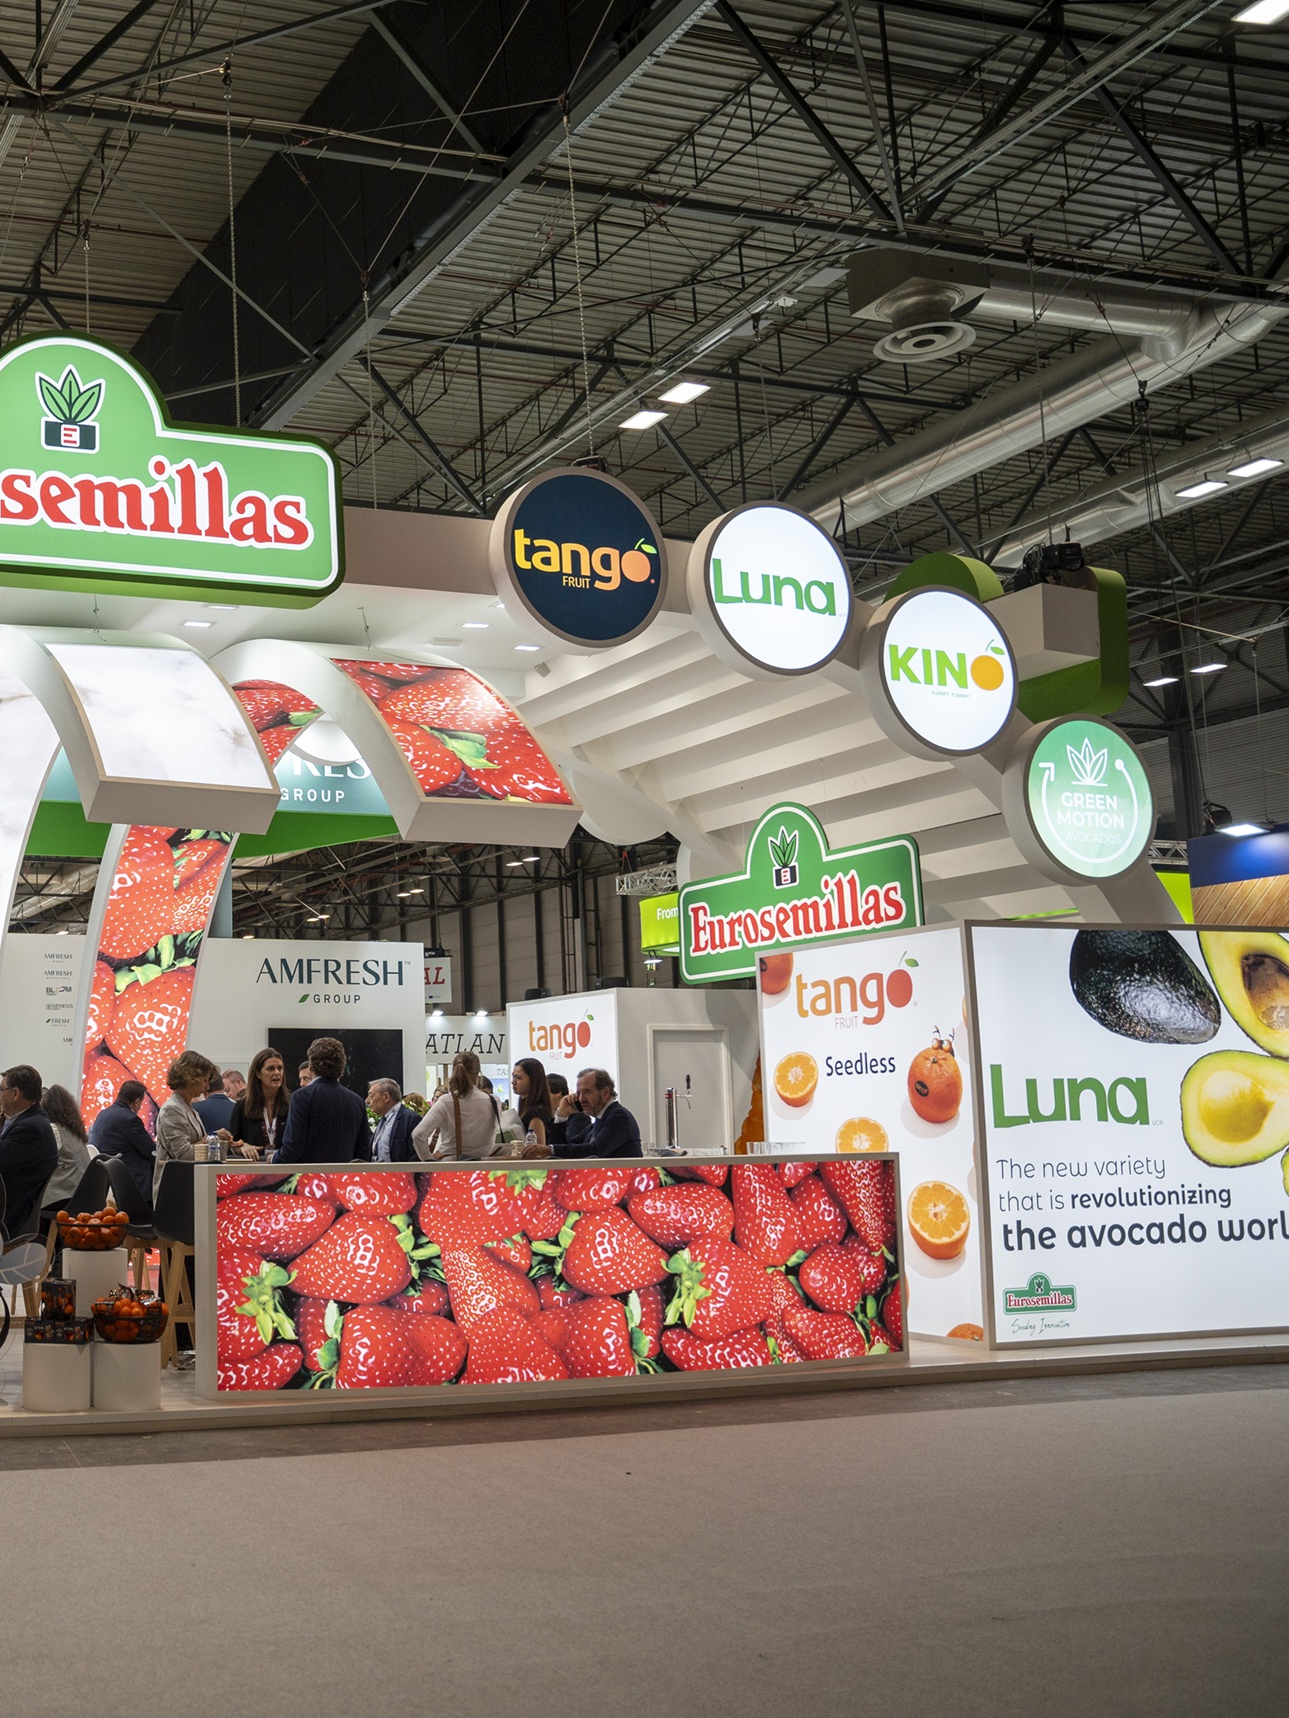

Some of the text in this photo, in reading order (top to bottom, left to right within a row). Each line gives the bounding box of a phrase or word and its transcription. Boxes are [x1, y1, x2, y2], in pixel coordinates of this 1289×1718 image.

[514, 528, 652, 591] tango
[562, 575, 591, 589] FRUIT
[712, 557, 837, 617] Luna
[888, 643, 1005, 692] KINO
[280, 787, 345, 803] GROUP
[1061, 791, 1118, 810] GREEN
[1056, 811, 1125, 828] MOTION
[1065, 831, 1122, 844] AVOCADOS
[656, 907, 679, 920] From
[689, 872, 905, 953] Eurosemillas
[256, 957, 404, 986] AMFRESH
[313, 994, 361, 1004] GROUP
[796, 969, 913, 1026] tango
[835, 1015, 859, 1029] FRUIT
[425, 1034, 506, 1055] ATLAN
[529, 1020, 592, 1060] tango
[825, 1052, 896, 1077] Seedless
[990, 1063, 1150, 1129] Luna
[996, 1154, 1166, 1180] The new variety
[999, 1183, 1232, 1212] that is revolutionizing
[1003, 1210, 1289, 1252] the avocado worl
[1008, 1291, 1073, 1308] Eurosemillas
